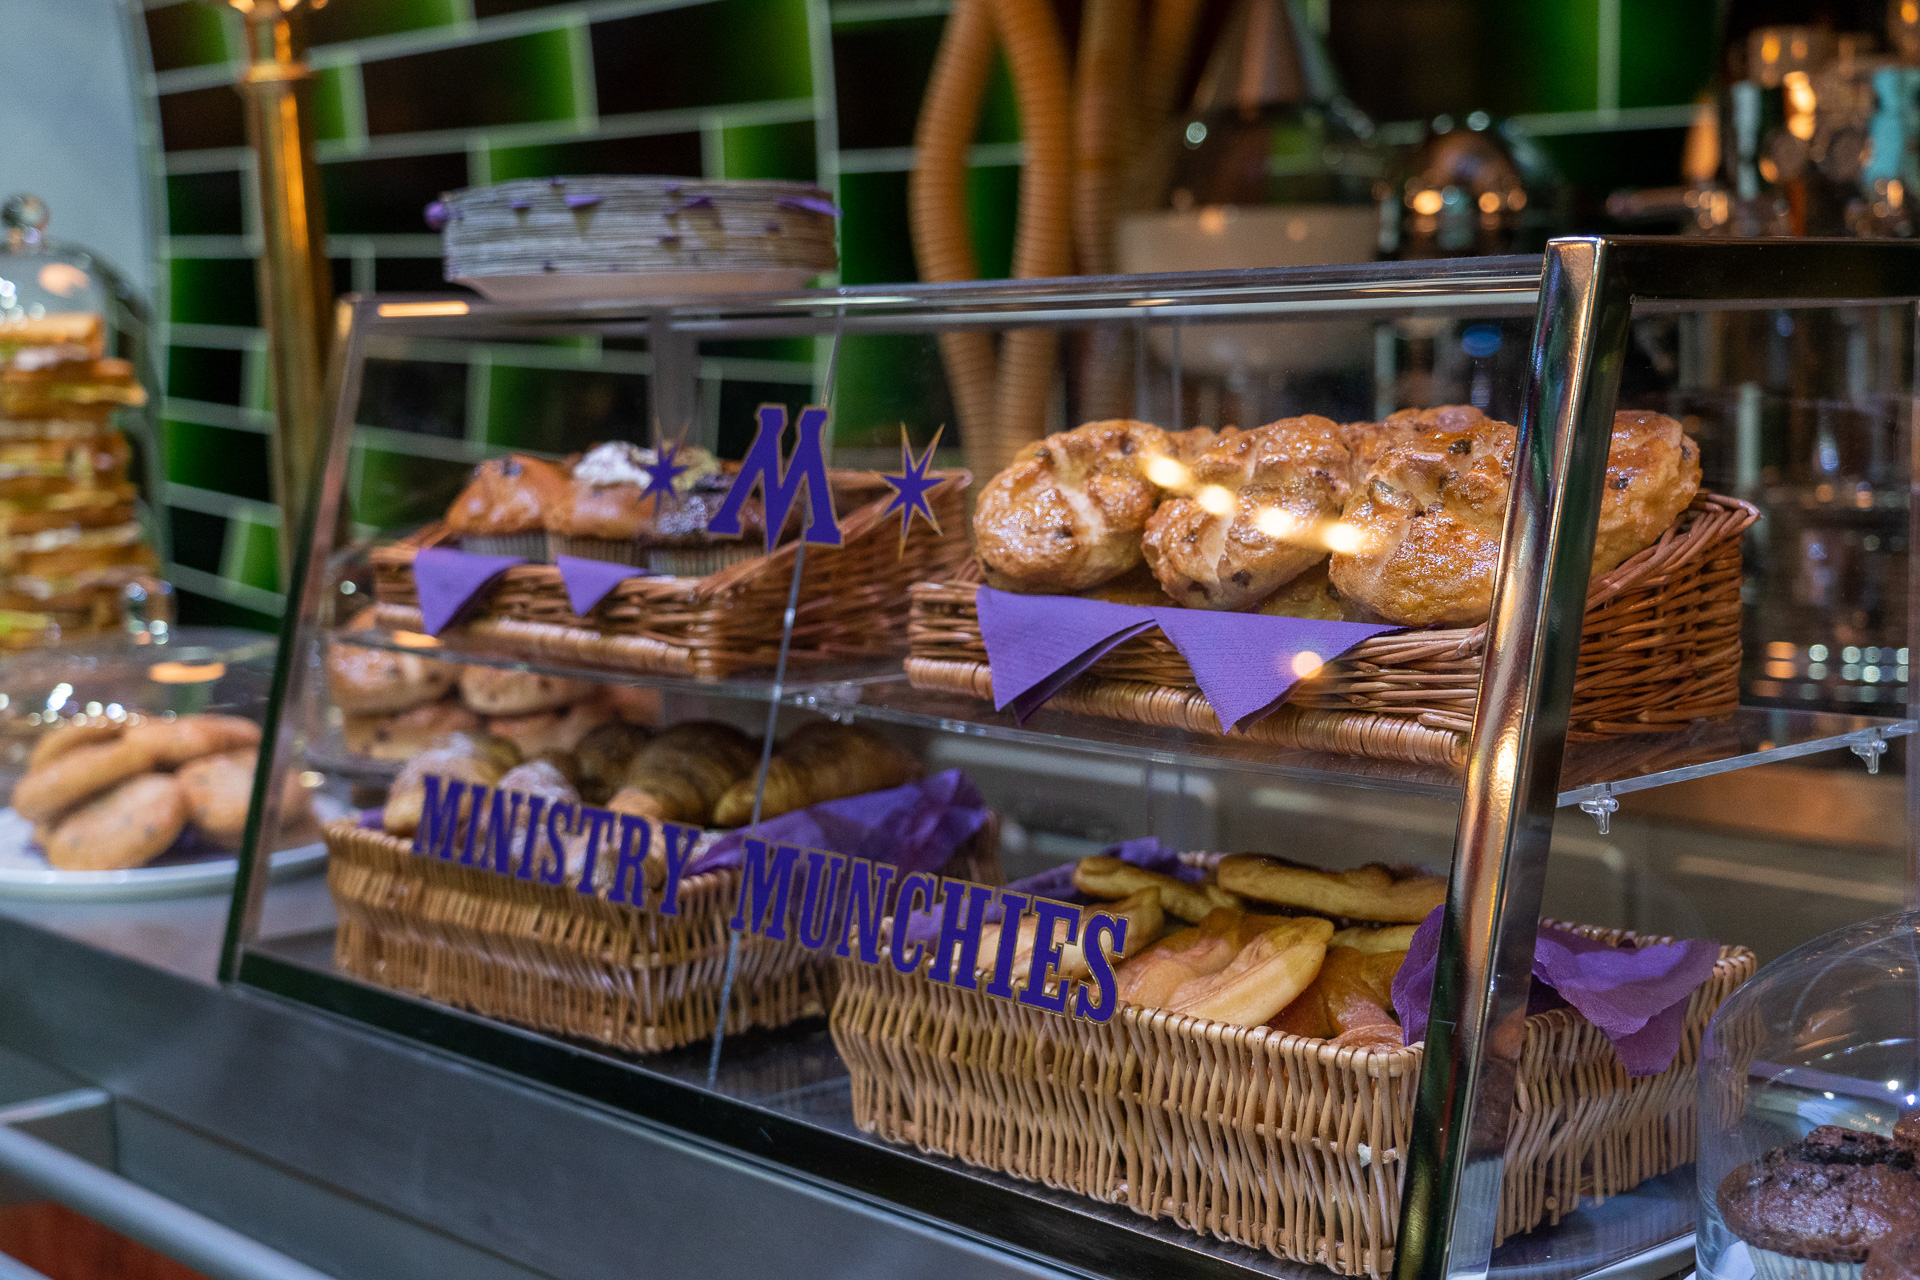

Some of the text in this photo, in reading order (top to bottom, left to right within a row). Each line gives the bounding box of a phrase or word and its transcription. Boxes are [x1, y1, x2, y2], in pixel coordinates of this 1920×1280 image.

[706, 403, 845, 556] M
[412, 773, 1131, 1026] MINISTRY MUNCHIES
